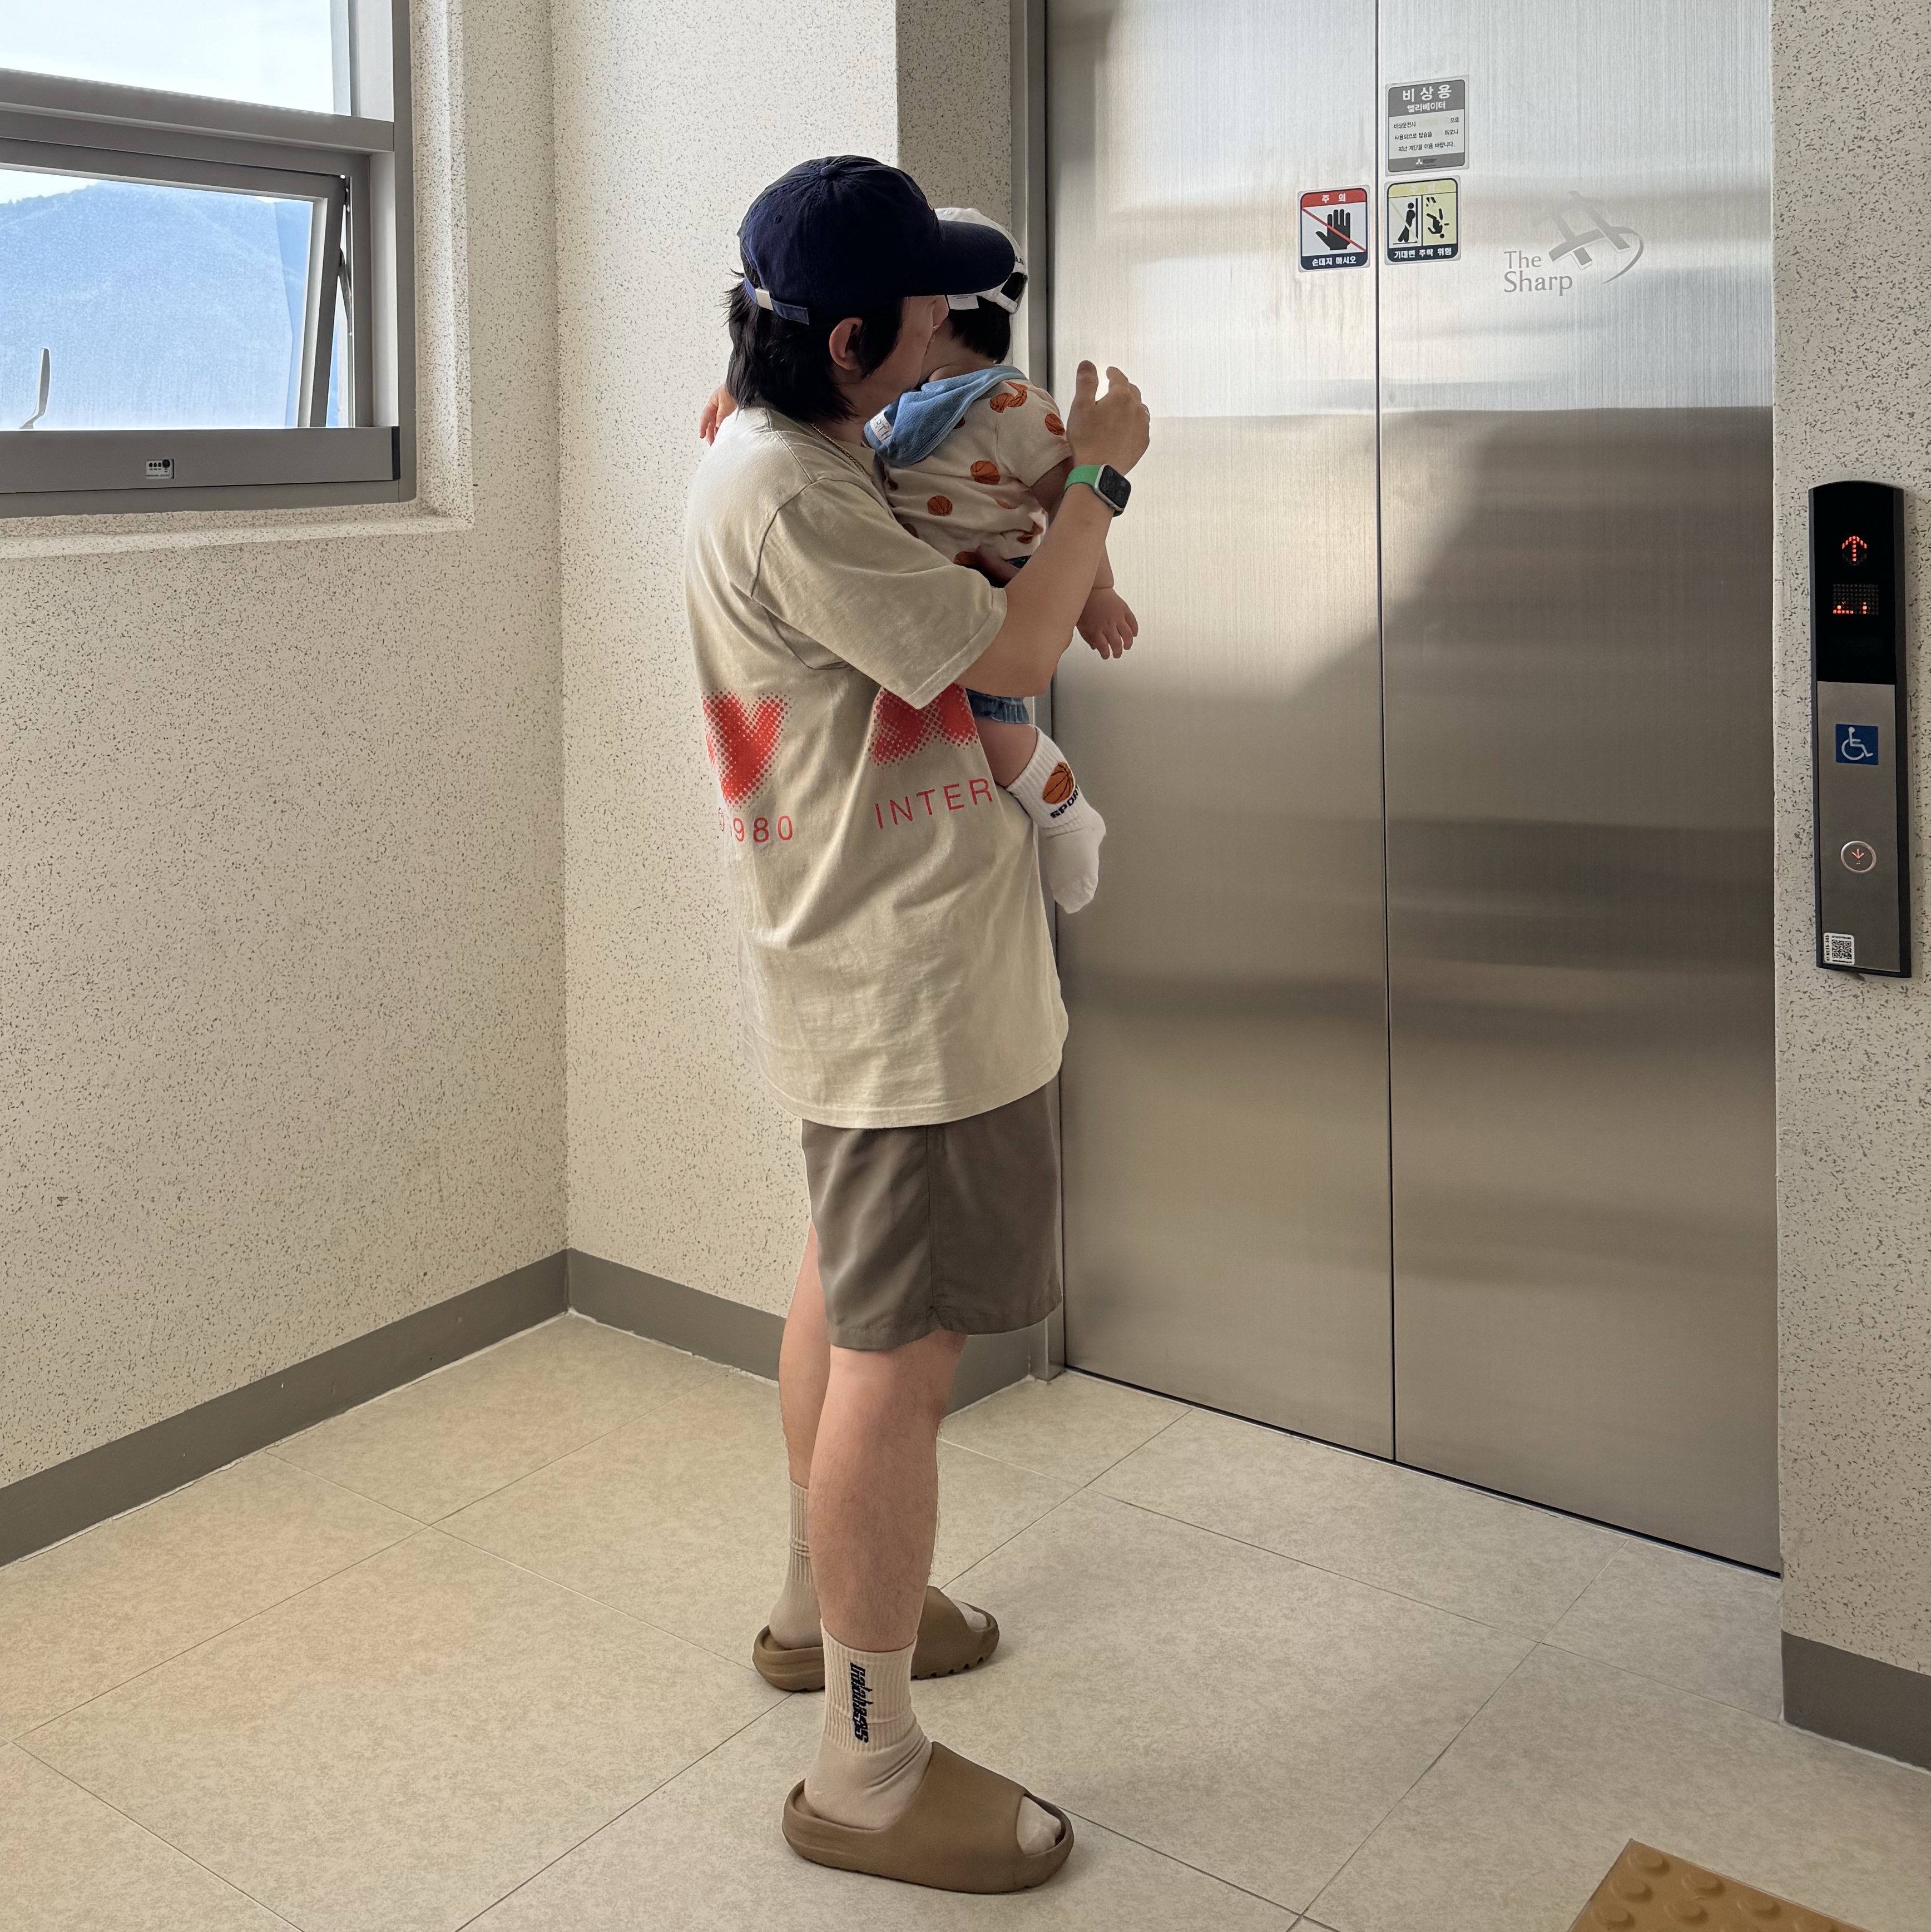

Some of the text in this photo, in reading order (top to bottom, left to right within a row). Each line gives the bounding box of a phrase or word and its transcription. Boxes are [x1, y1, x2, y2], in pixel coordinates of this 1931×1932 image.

[1407, 101, 1445, 113] 엘리베이터
[1394, 247, 1452, 259] 기대면 추락 위험
[1504, 250, 1541, 269] The
[1312, 256, 1356, 266] 손대지 마시오
[1504, 270, 1573, 296] Sharp
[875, 778, 993, 829] INTER
